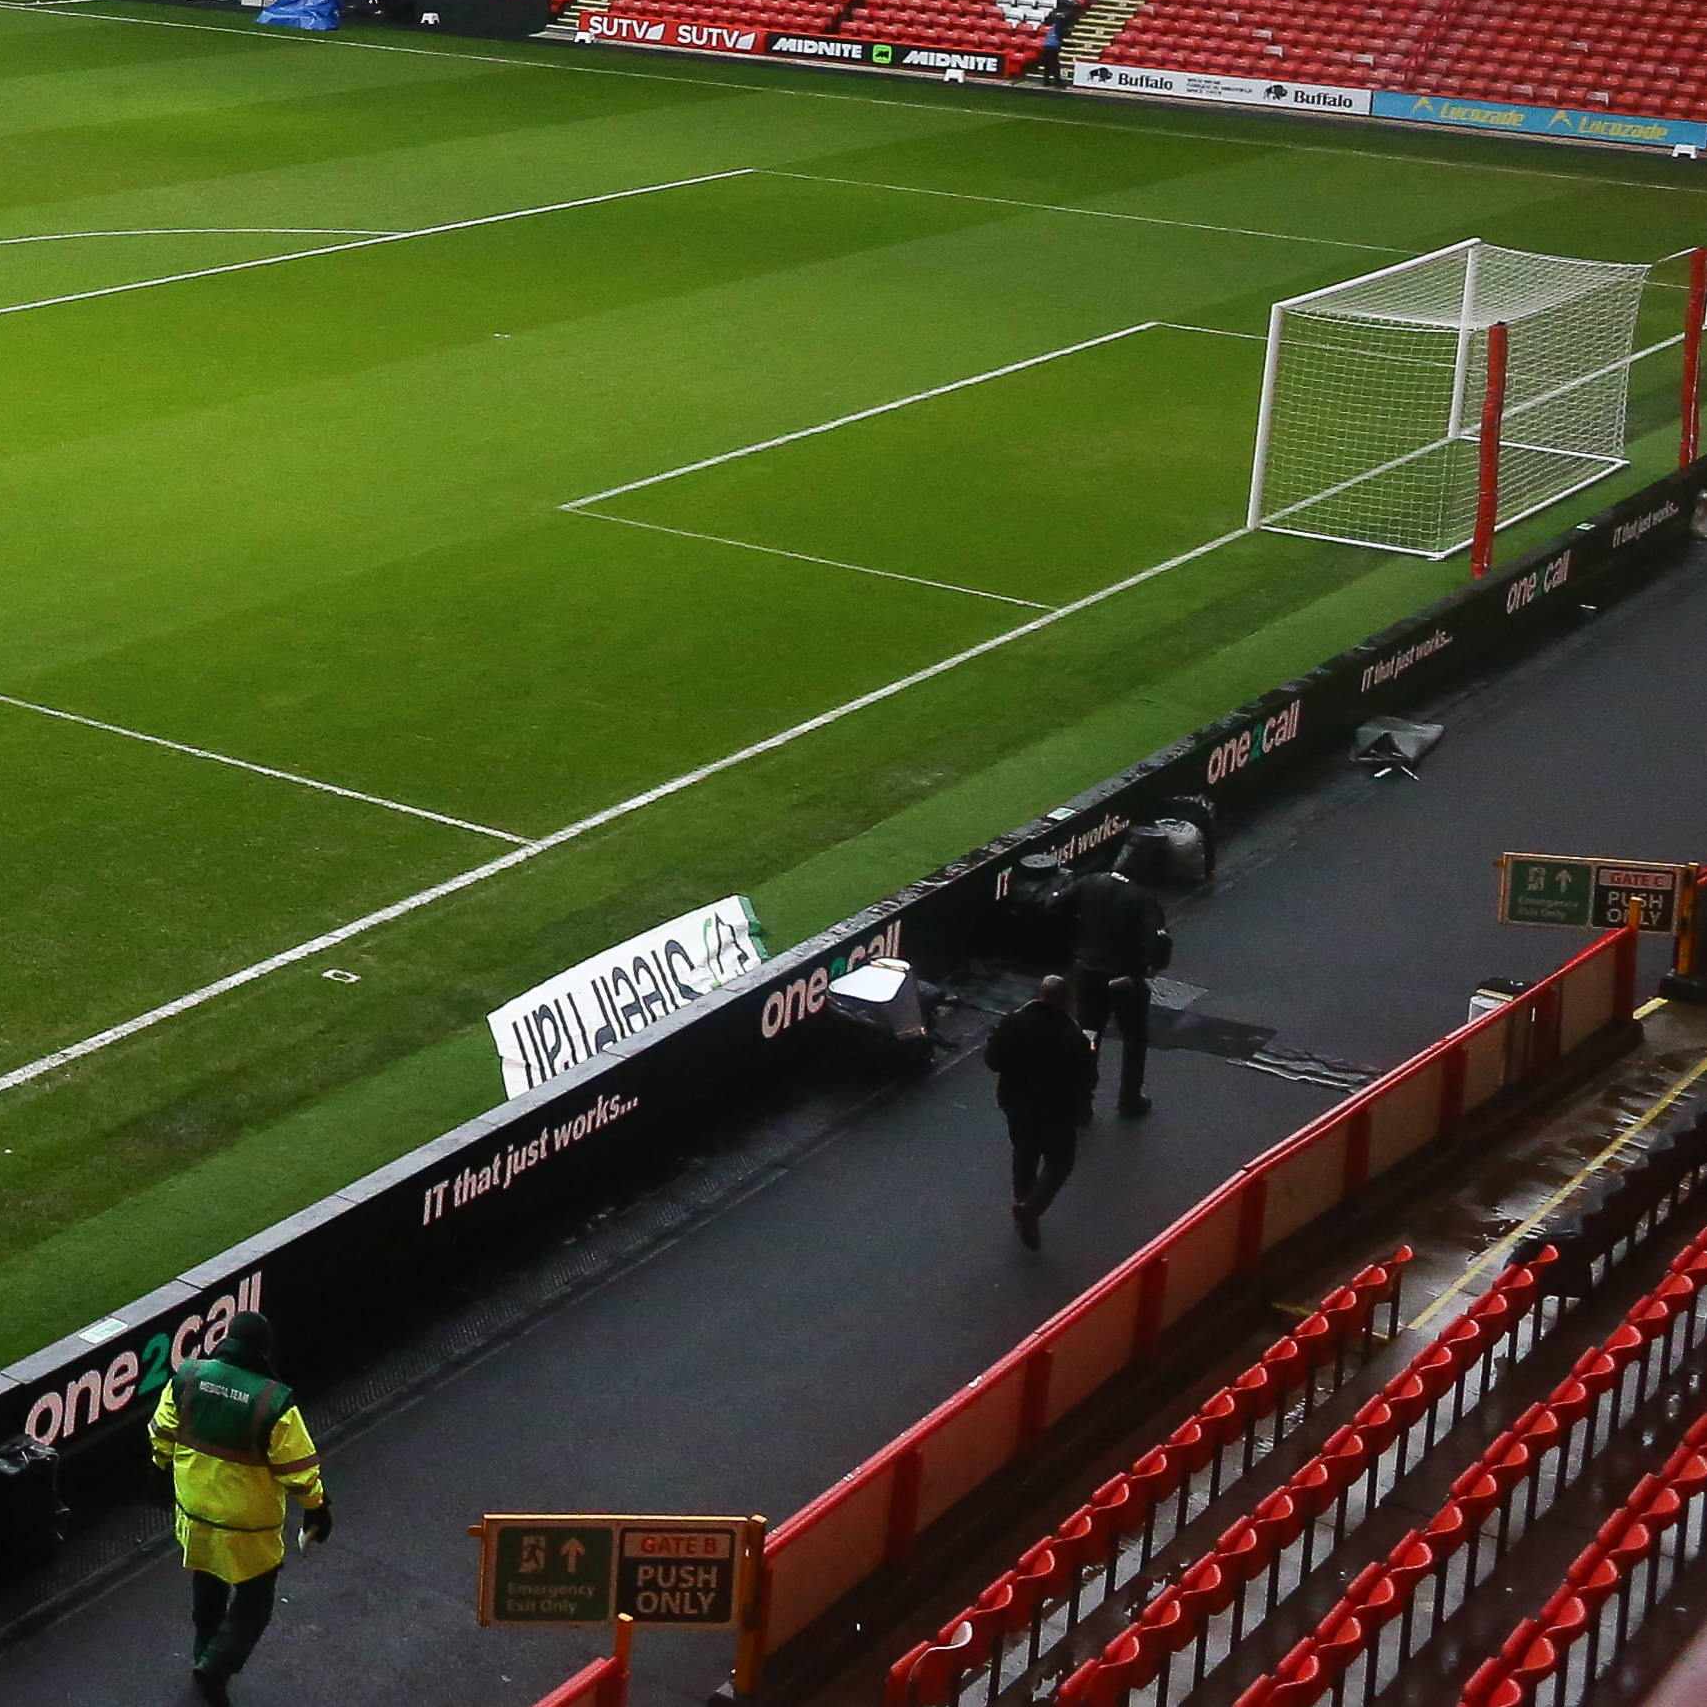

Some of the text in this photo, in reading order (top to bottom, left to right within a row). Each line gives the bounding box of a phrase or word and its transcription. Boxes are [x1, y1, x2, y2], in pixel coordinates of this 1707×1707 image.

[588, 17, 650, 38] SUTV
[677, 25, 741, 47] SUTV
[772, 37, 863, 60] MIDNITE
[902, 49, 998, 72] MIDNITE
[1118, 72, 1173, 91] Buffalo
[1293, 90, 1353, 109] Buffalo
[1439, 101, 1526, 127] Lucozade
[1207, 699, 1301, 785] one2call
[1610, 873, 1664, 886] GATE C
[422, 1094, 639, 1227] IT that just works...
[25, 1271, 263, 1447] one2call
[199, 1381, 250, 1404] MEDICAL TEAM
[640, 1536, 718, 1556] GATE B
[636, 1564, 718, 1590] PUSH
[506, 1581, 597, 1598] Emergency
[506, 1597, 578, 1615] Exit Only
[635, 1590, 717, 1616] ONLY
